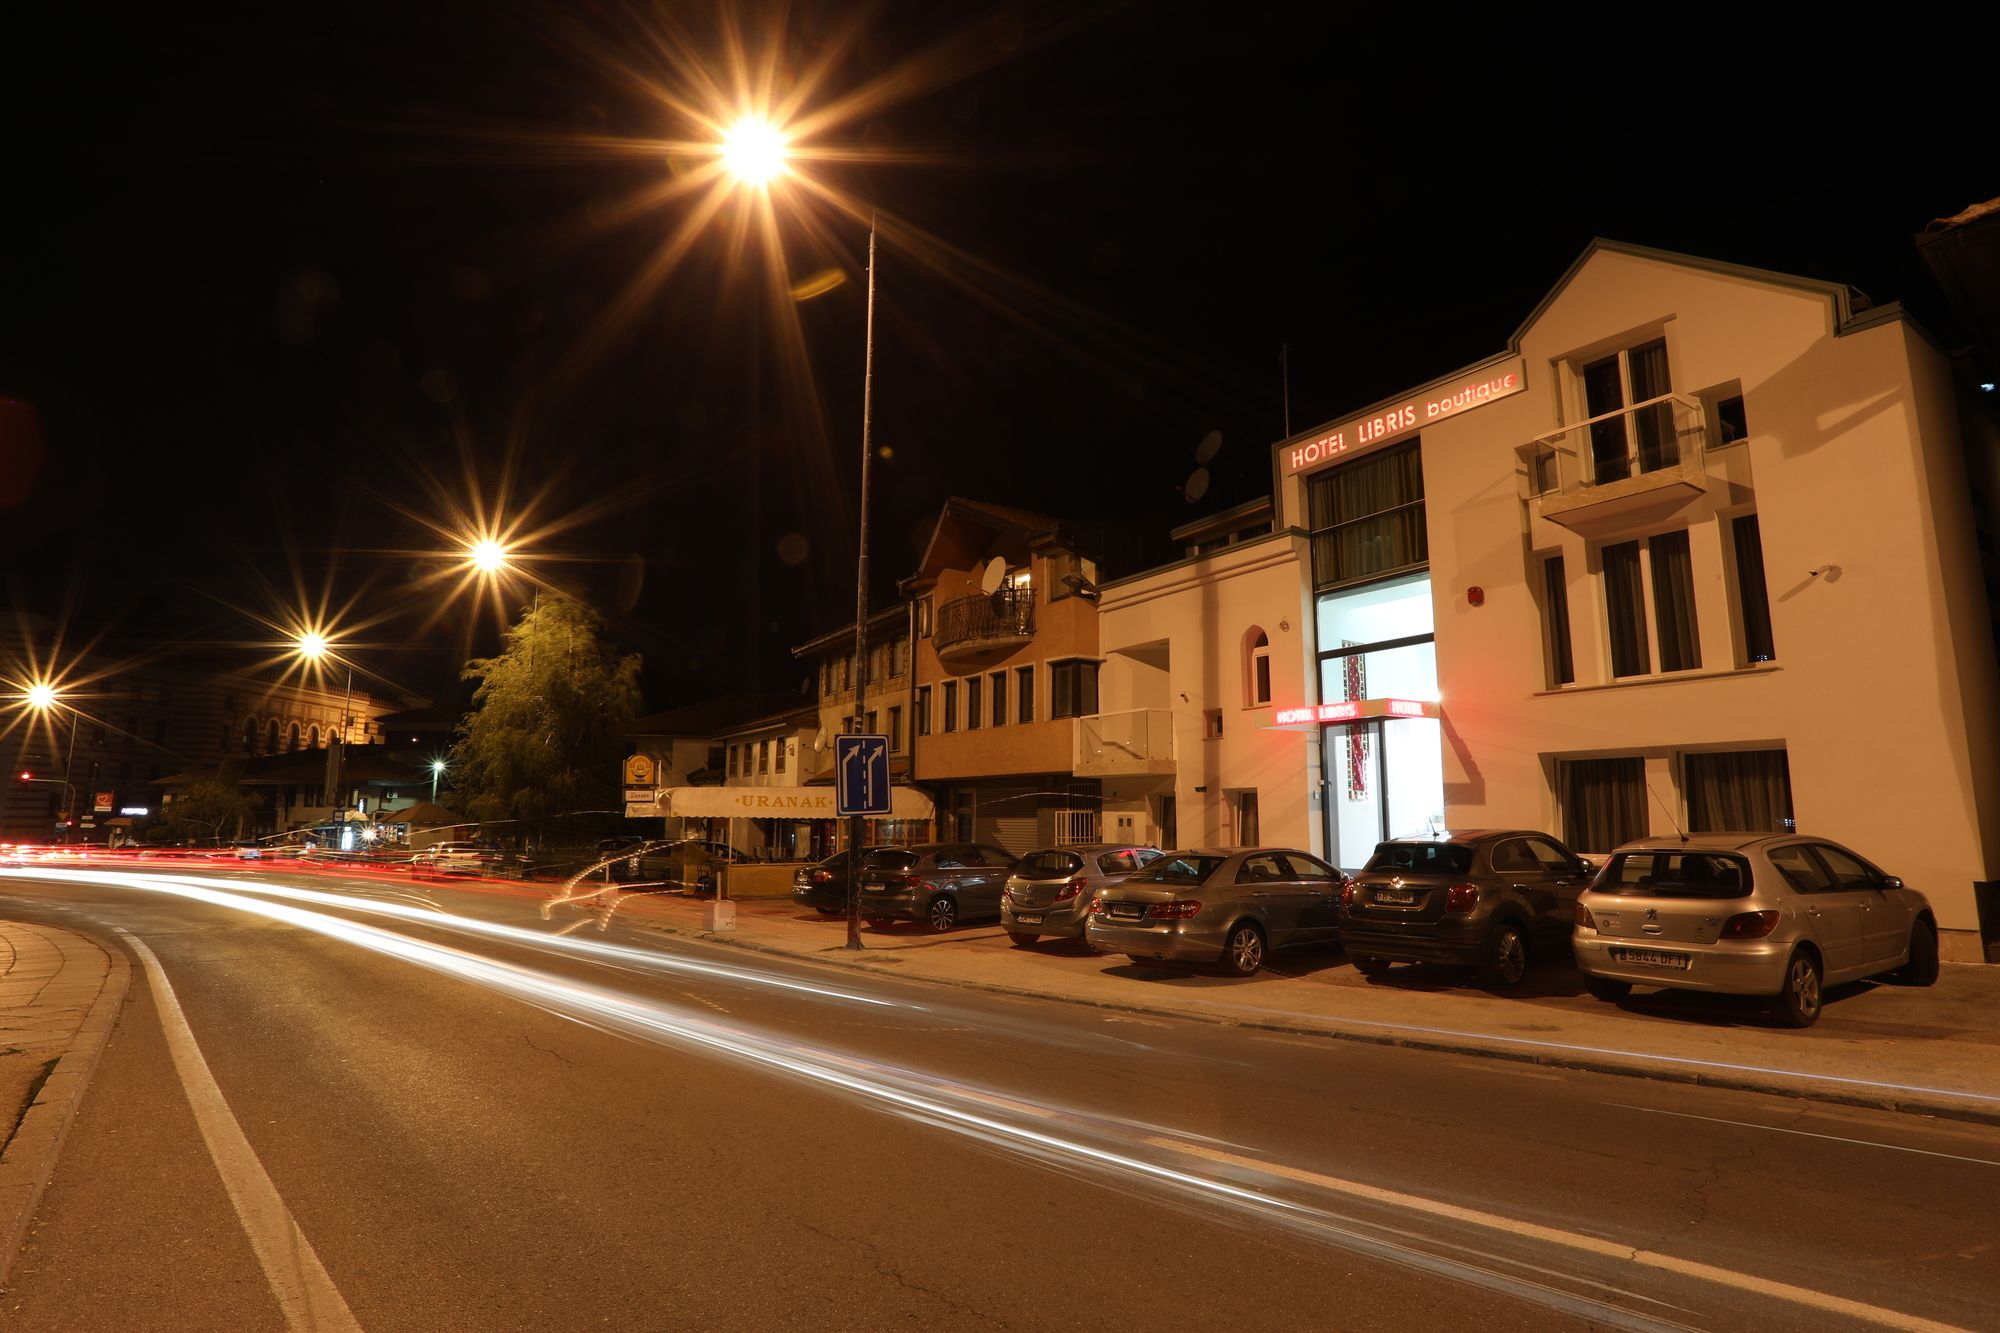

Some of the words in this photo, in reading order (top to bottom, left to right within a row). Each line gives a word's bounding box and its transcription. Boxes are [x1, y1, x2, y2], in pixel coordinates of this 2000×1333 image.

[1292, 433, 1347, 468] HOTEL
[1358, 405, 1416, 443] LIBRIS
[1427, 374, 1517, 417] boutique
